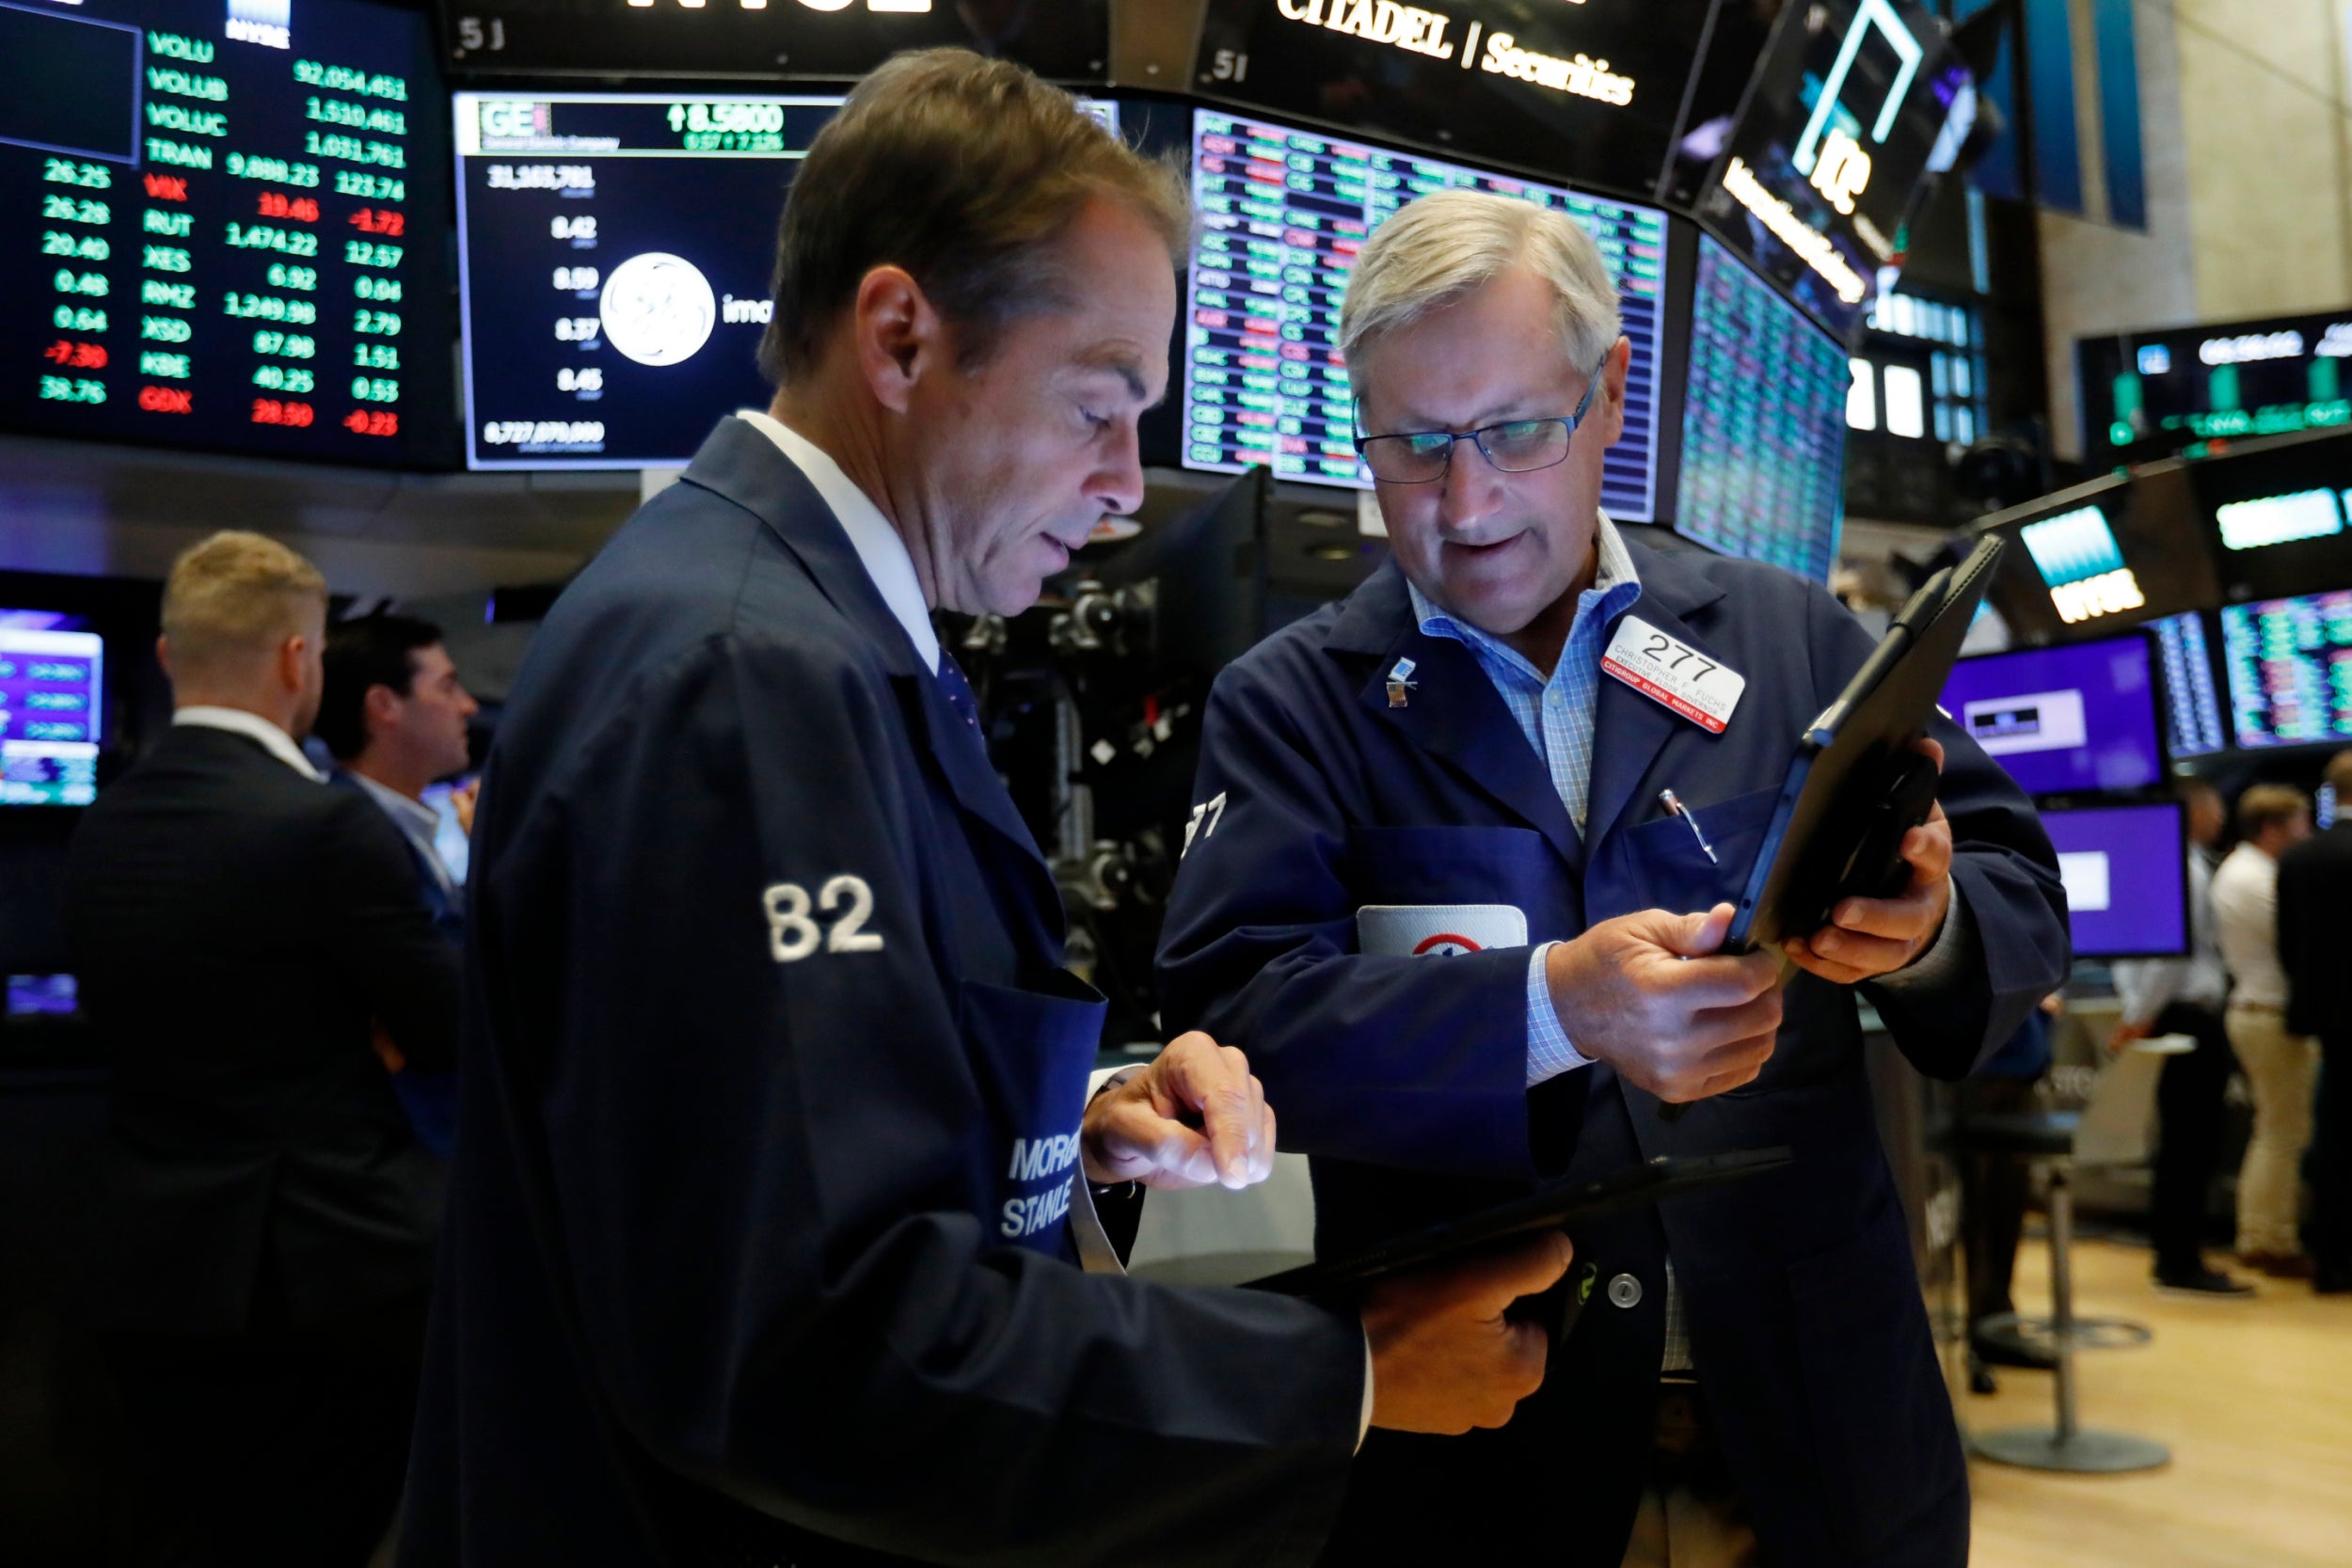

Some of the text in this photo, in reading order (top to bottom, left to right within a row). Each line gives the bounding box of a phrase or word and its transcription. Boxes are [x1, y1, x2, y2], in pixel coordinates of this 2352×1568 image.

[147, 30, 215, 63] VOLU
[1480, 31, 1636, 106] Securities
[145, 102, 228, 136] VOLUC
[482, 102, 535, 137] GE
[145, 136, 213, 169] TRAN
[143, 209, 195, 237] RUT
[1615, 656, 1650, 678] EXECUTIVE
[1643, 634, 1717, 682] 277
[1603, 661, 1719, 729] CITIGROUP GLOBAL MARKETS INC
[1614, 644, 1677, 682] CHRISTOPHER
[1694, 689, 1727, 711] FUCHS
[763, 874, 884, 963] 82
